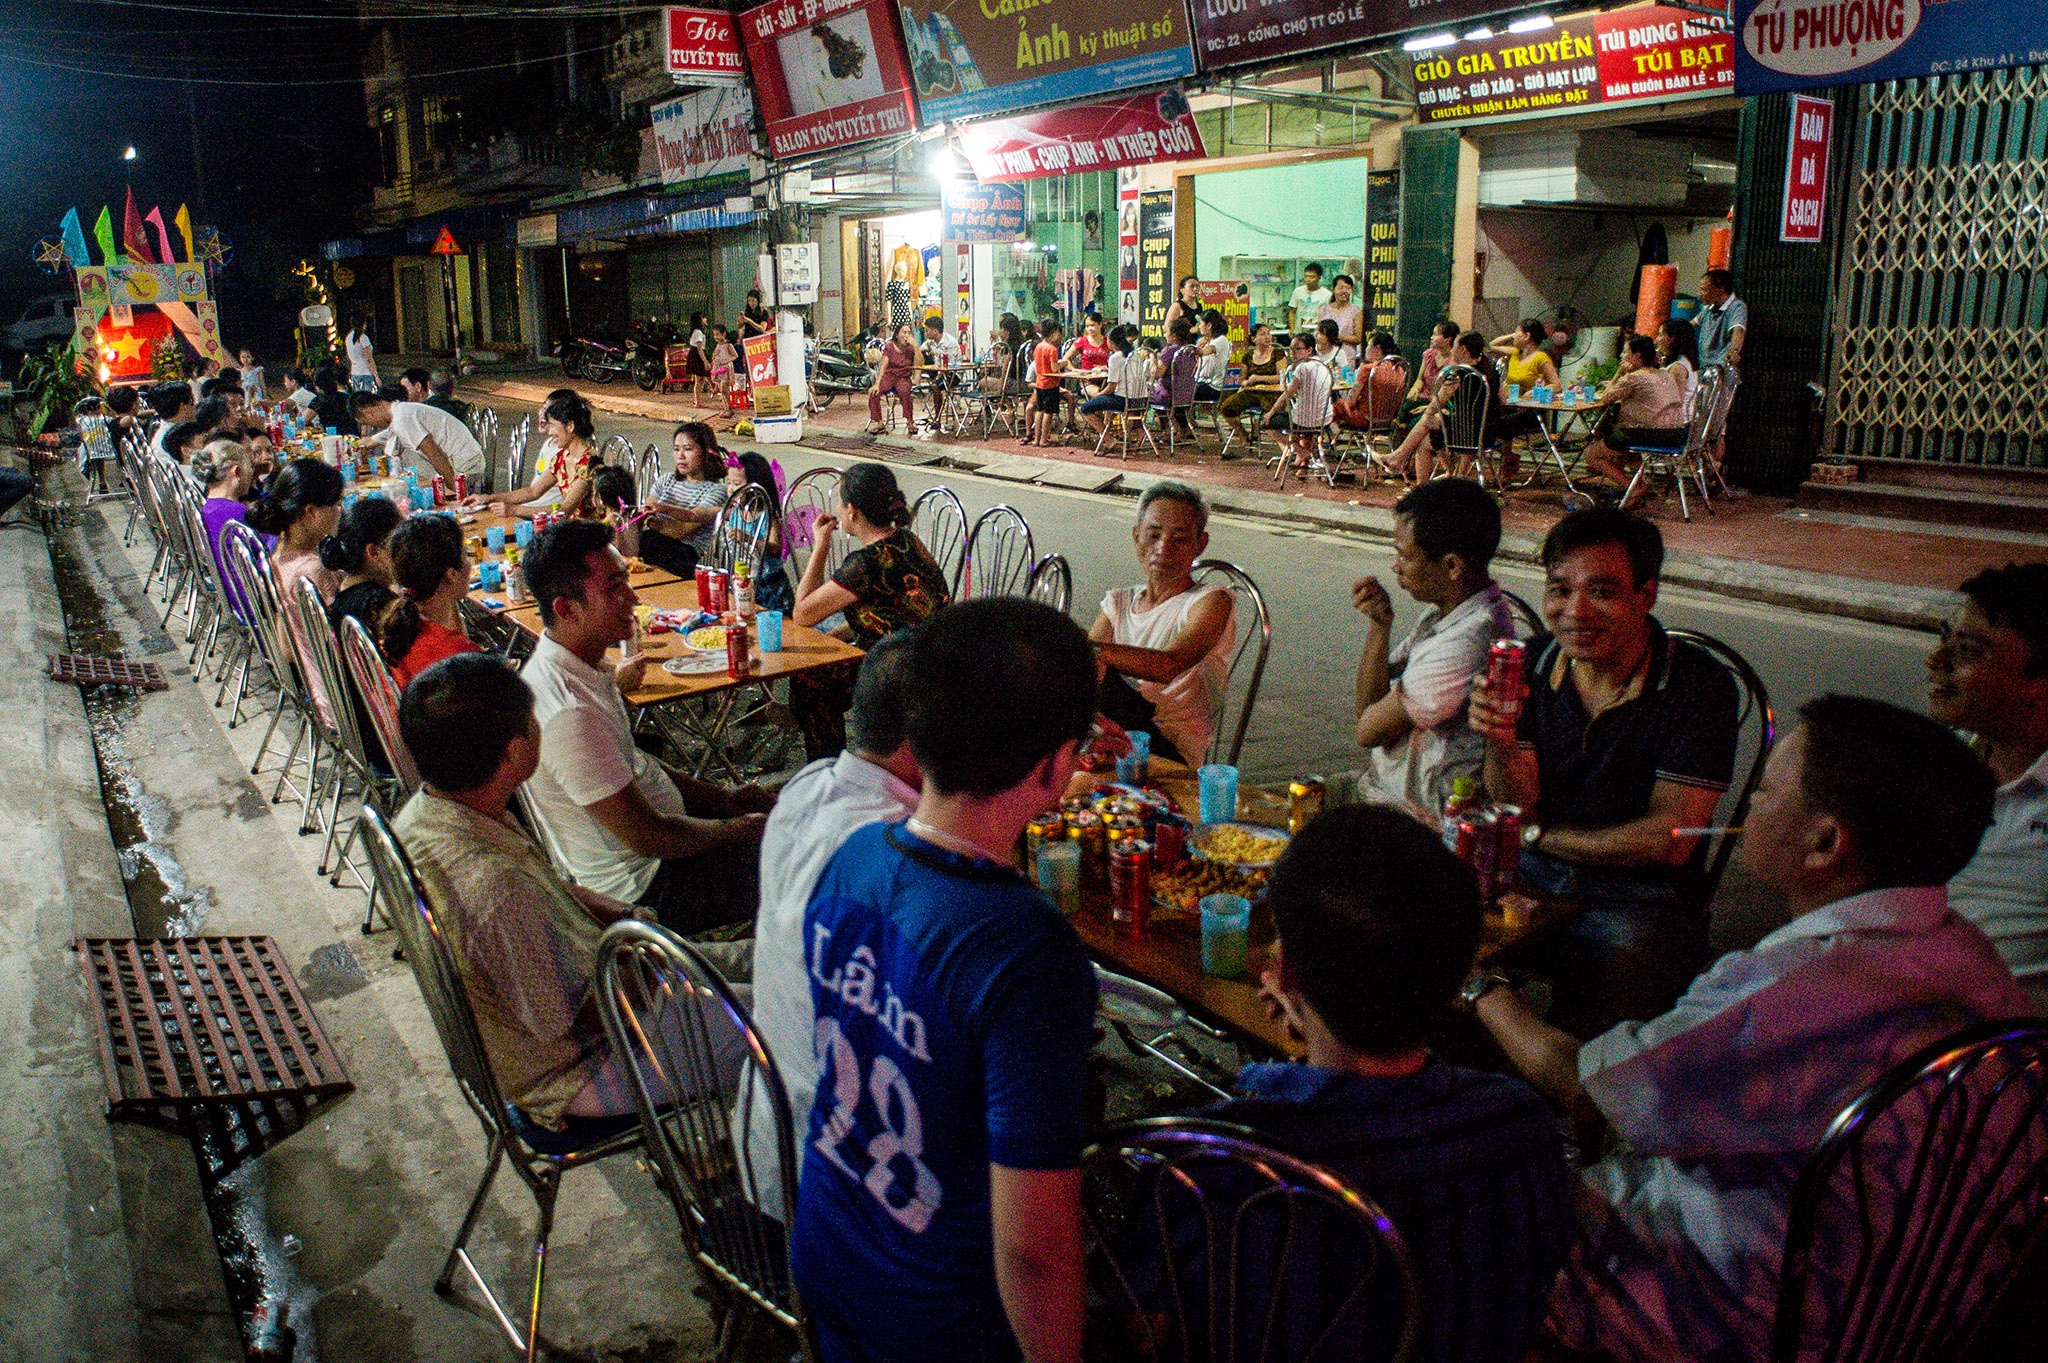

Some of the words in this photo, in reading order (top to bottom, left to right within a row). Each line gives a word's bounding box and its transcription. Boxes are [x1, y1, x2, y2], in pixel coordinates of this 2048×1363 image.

[685, 16, 730, 42] Tóc
[1016, 16, 1070, 69] Ảnh
[1079, 31, 1097, 57] kỹ
[1103, 20, 1147, 50] thuật
[1152, 8, 1173, 39] số
[1227, 33, 1240, 47] 22
[1282, 16, 1307, 36] CHỢ
[1309, 15, 1324, 30] TT
[1598, 27, 1626, 52] TÚI
[1629, 22, 1678, 49] ĐỰNG
[1681, 15, 1734, 39] NILO
[671, 44, 715, 65] TUYẾT
[1414, 55, 1451, 82] GIÒ
[1456, 53, 1496, 76] GIA
[1498, 30, 1594, 69] TRUYỀN
[1633, 47, 1673, 74] TÚI
[1680, 43, 1727, 69] BẠT
[1955, 58, 1969, 70] 24
[1418, 86, 1437, 105] GIÒ
[1437, 86, 1461, 104] NẠC
[1469, 79, 1489, 98] GIÒ
[1523, 71, 1543, 91] GIÒ
[1546, 70, 1569, 89] HẠT
[1606, 80, 1630, 97] BÁN
[1631, 79, 1663, 94] BUÔN
[1665, 75, 1690, 90] BÁN
[1717, 69, 1735, 83] ĐT:
[1430, 105, 1471, 120] CHUYÊN
[1473, 99, 1504, 116] NHẬN
[1505, 97, 1528, 110] LÀM
[1531, 93, 1562, 107] HÀNG
[1565, 89, 1588, 104] ĐẶT
[774, 128, 811, 155] SALON
[811, 120, 836, 146] TÓC
[834, 105, 876, 141] TUYẾT
[876, 102, 906, 132] THƯ
[1799, 107, 1824, 144] BÁN
[1003, 149, 1036, 175] PHIM
[1037, 145, 1071, 175] CHỤP
[1070, 136, 1105, 168] ẢNH
[1104, 138, 1124, 163] IN
[1121, 127, 1160, 164] THIỆP
[1160, 121, 1196, 156] CƯỚI
[1800, 153, 1816, 186] ĐÁ
[990, 190, 1023, 211] Ảnh
[1789, 199, 1819, 232] SẠCH
[1142, 238, 1170, 255] CHỤP
[1370, 223, 1397, 242] QUA
[1145, 252, 1168, 269] ẢNH
[1370, 269, 1395, 289] CHỤ
[1144, 304, 1166, 321] LẤY
[1224, 298, 1248, 317] Phim
[745, 337, 771, 357] TUYẾT
[752, 353, 777, 383] CẮ
[811, 920, 934, 1065] Lâm
[813, 1015, 945, 1236] 28
